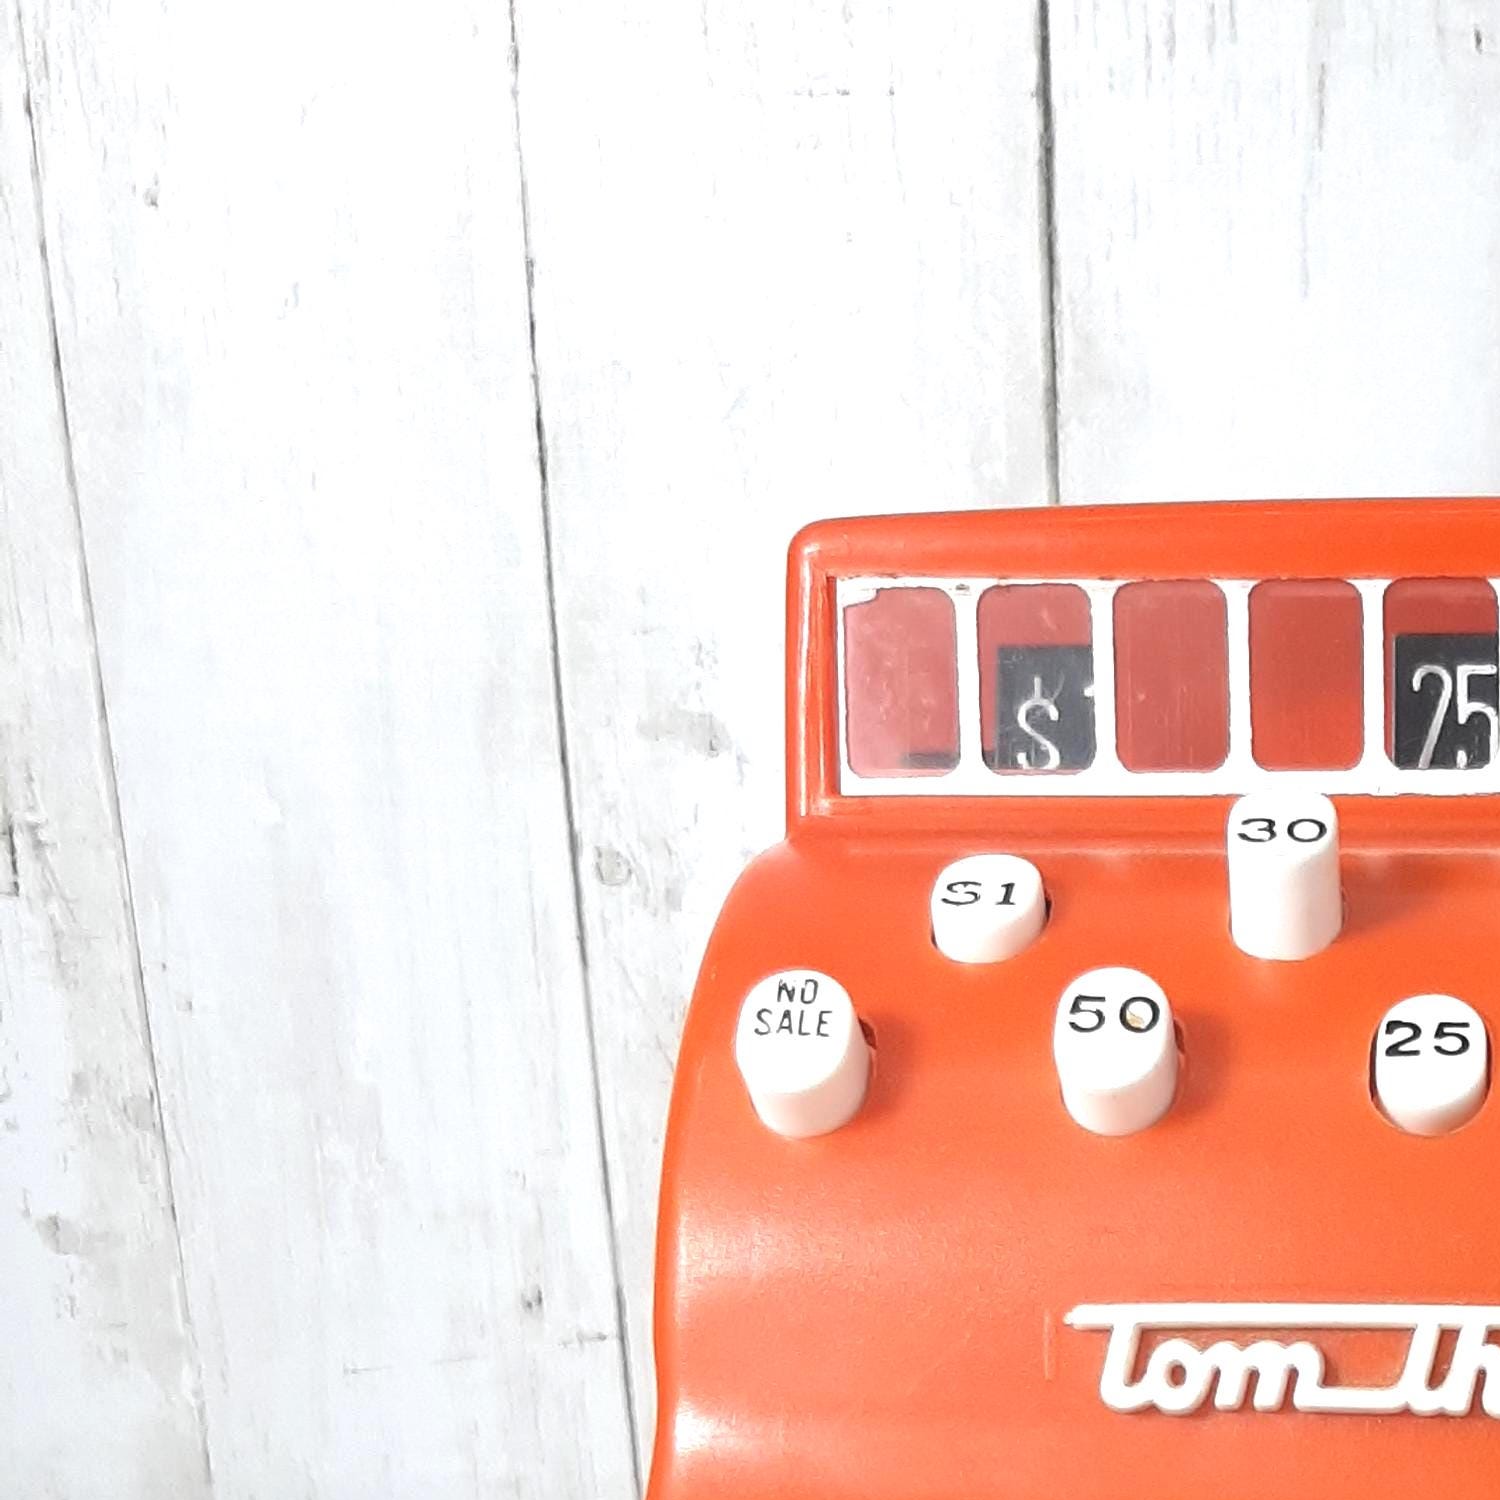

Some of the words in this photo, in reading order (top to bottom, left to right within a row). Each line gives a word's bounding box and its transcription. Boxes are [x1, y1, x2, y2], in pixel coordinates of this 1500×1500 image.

[1412, 664, 1500, 768] 25
[1237, 818, 1328, 843] 30
[777, 978, 819, 1005] NO
[754, 1008, 831, 1037] SALE
[1068, 994, 1161, 1034] 50
[1384, 1019, 1470, 1057] 25
[1064, 1302, 1330, 1416] Tom
